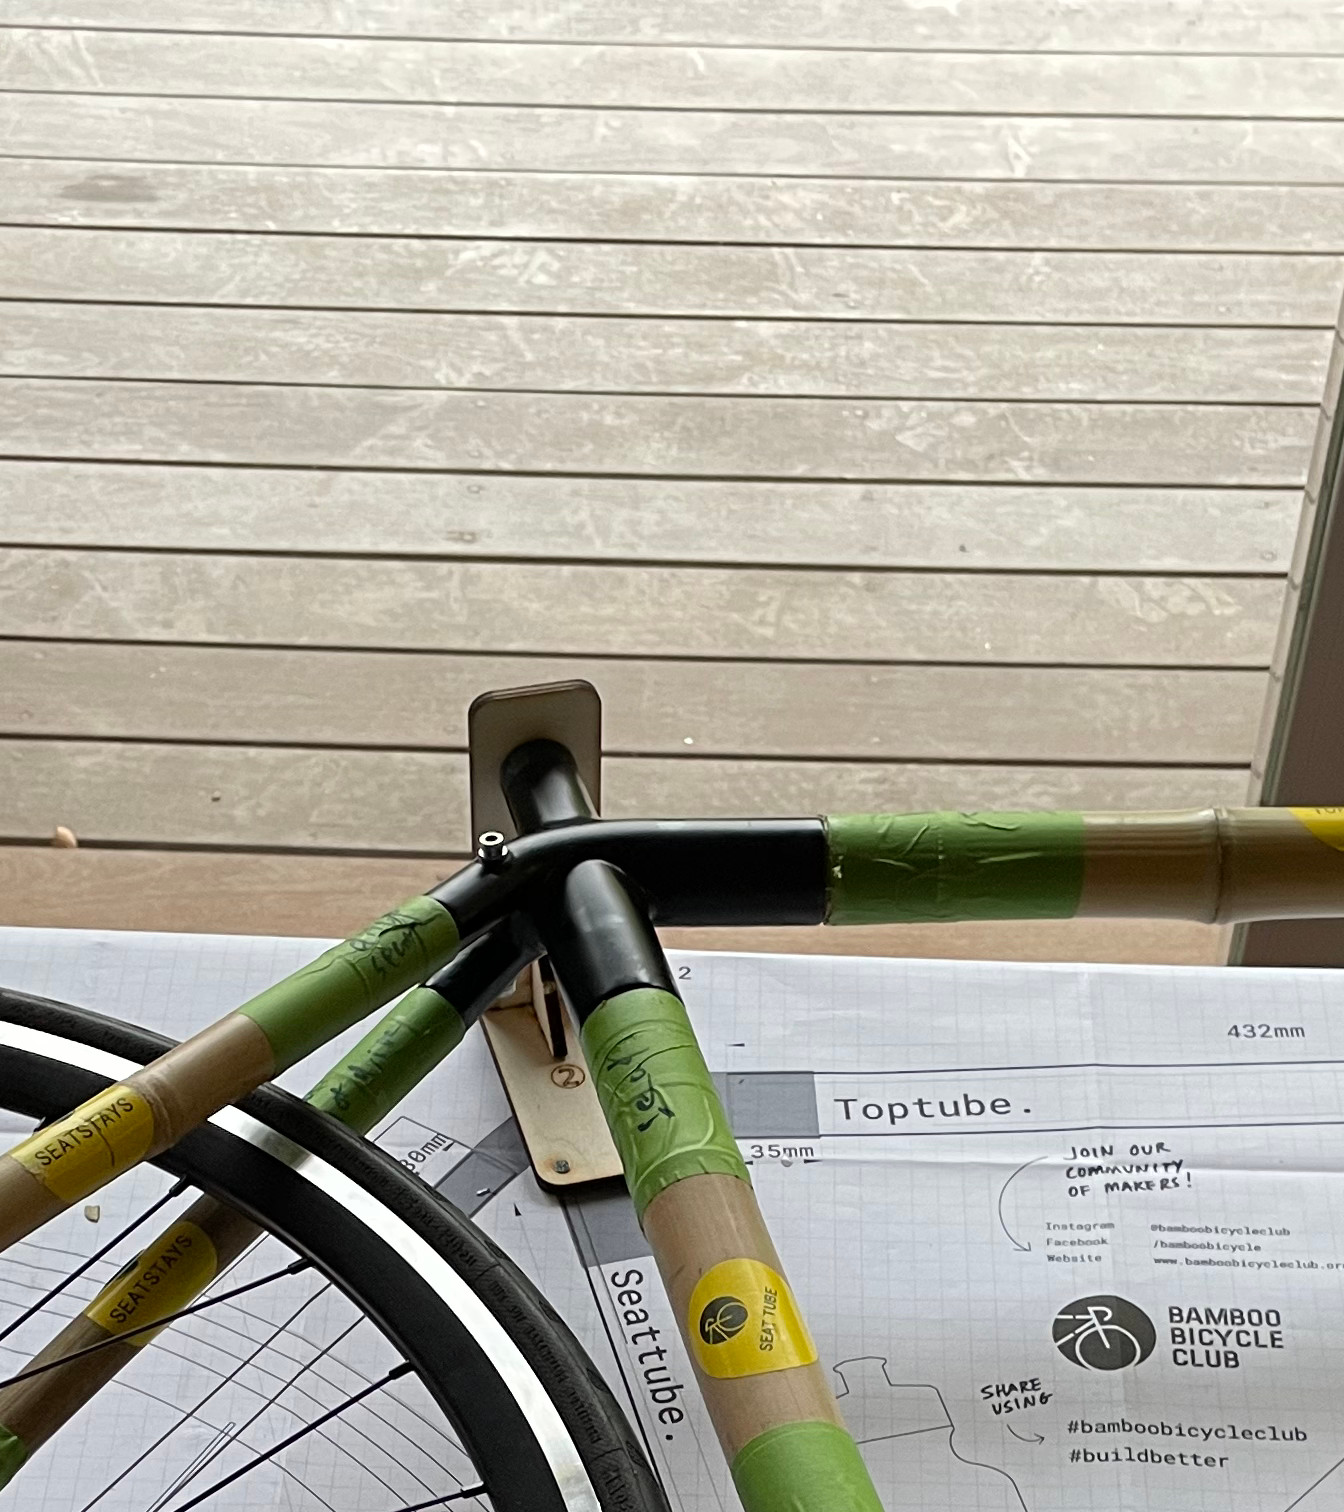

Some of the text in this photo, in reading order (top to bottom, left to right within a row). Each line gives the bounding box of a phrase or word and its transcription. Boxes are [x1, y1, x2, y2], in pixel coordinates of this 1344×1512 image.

[678, 965, 692, 980] 2
[1227, 1023, 1305, 1039] 432mm
[835, 1093, 1033, 1124] Toptube.
[34, 1096, 135, 1169] SEATSTAYS
[750, 1142, 815, 1160] 35mm
[1064, 1142, 1172, 1161] JOIN OUR
[1065, 1160, 1184, 1179] COMMUNITY
[1068, 1173, 1193, 1197] OF MAKERS!
[1046, 1222, 1116, 1232] Instagram
[1046, 1238, 1109, 1247] Facebook
[1047, 1254, 1103, 1263] Website
[109, 1232, 193, 1326] SEATSTAYS
[758, 1285, 779, 1352] SEAT TUBE
[1168, 1305, 1282, 1327] BAMBOO
[1170, 1327, 1285, 1349] BICYCLE
[610, 1268, 684, 1442] Seattube.
[1172, 1349, 1240, 1369] CLUB
[981, 1378, 1043, 1402] SHARE
[991, 1392, 1053, 1417] USING
[1067, 1418, 1308, 1443] #bamboobicycleclub
[1069, 1448, 1229, 1469] #buildbetter
